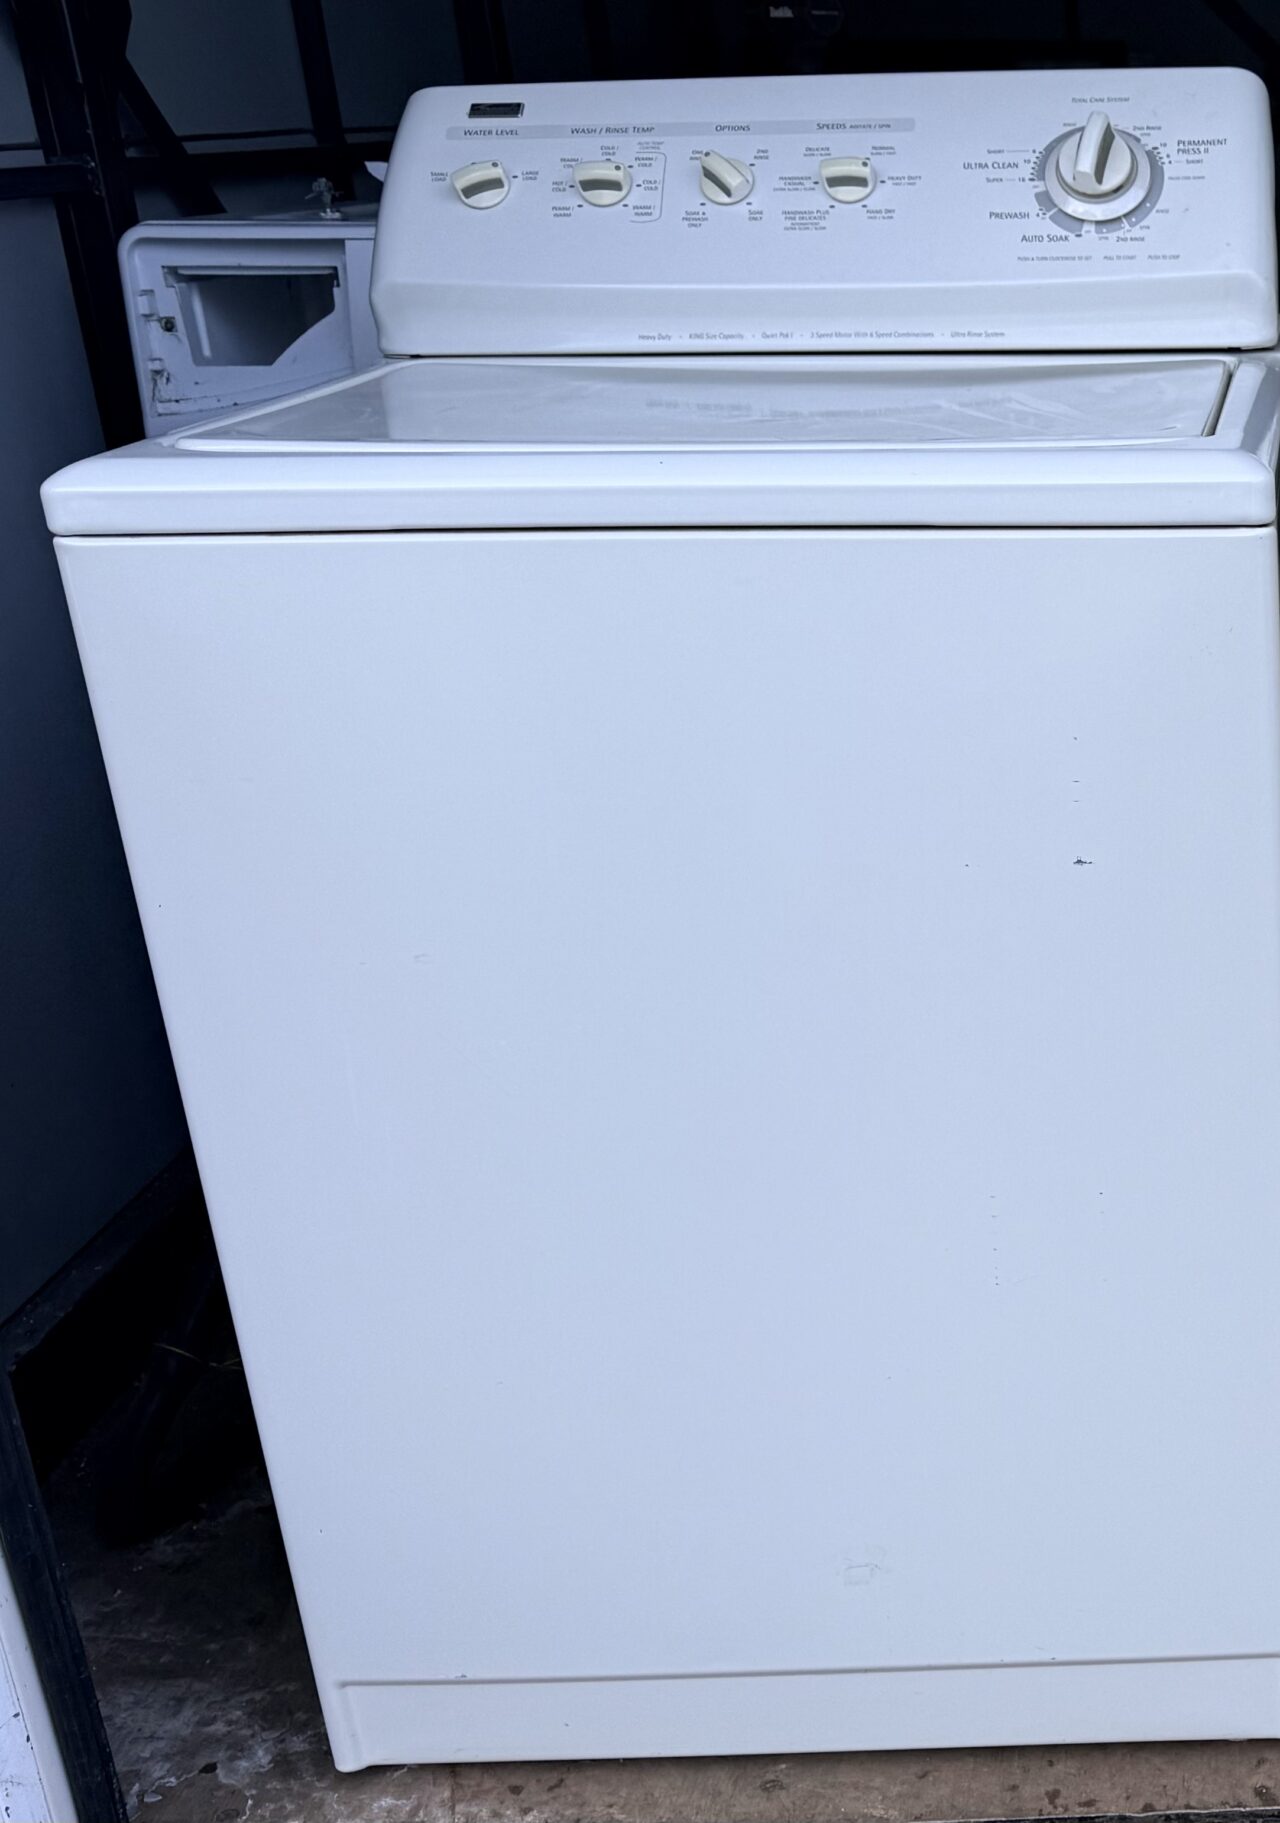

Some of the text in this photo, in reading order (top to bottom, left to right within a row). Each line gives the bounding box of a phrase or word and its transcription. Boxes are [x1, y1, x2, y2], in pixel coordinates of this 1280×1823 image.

[570, 127, 597, 135] WASH
[605, 126, 629, 134] RINSE
[715, 124, 751, 132] OPTIONS
[816, 122, 847, 130] SPEEDS
[1177, 138, 1227, 147] PERMANENT
[1177, 147, 1201, 155] PRESS
[963, 161, 1019, 170] ULTRA CLEAN
[989, 211, 1030, 220] PREWASH
[1021, 233, 1070, 243] AUTO SOAK
